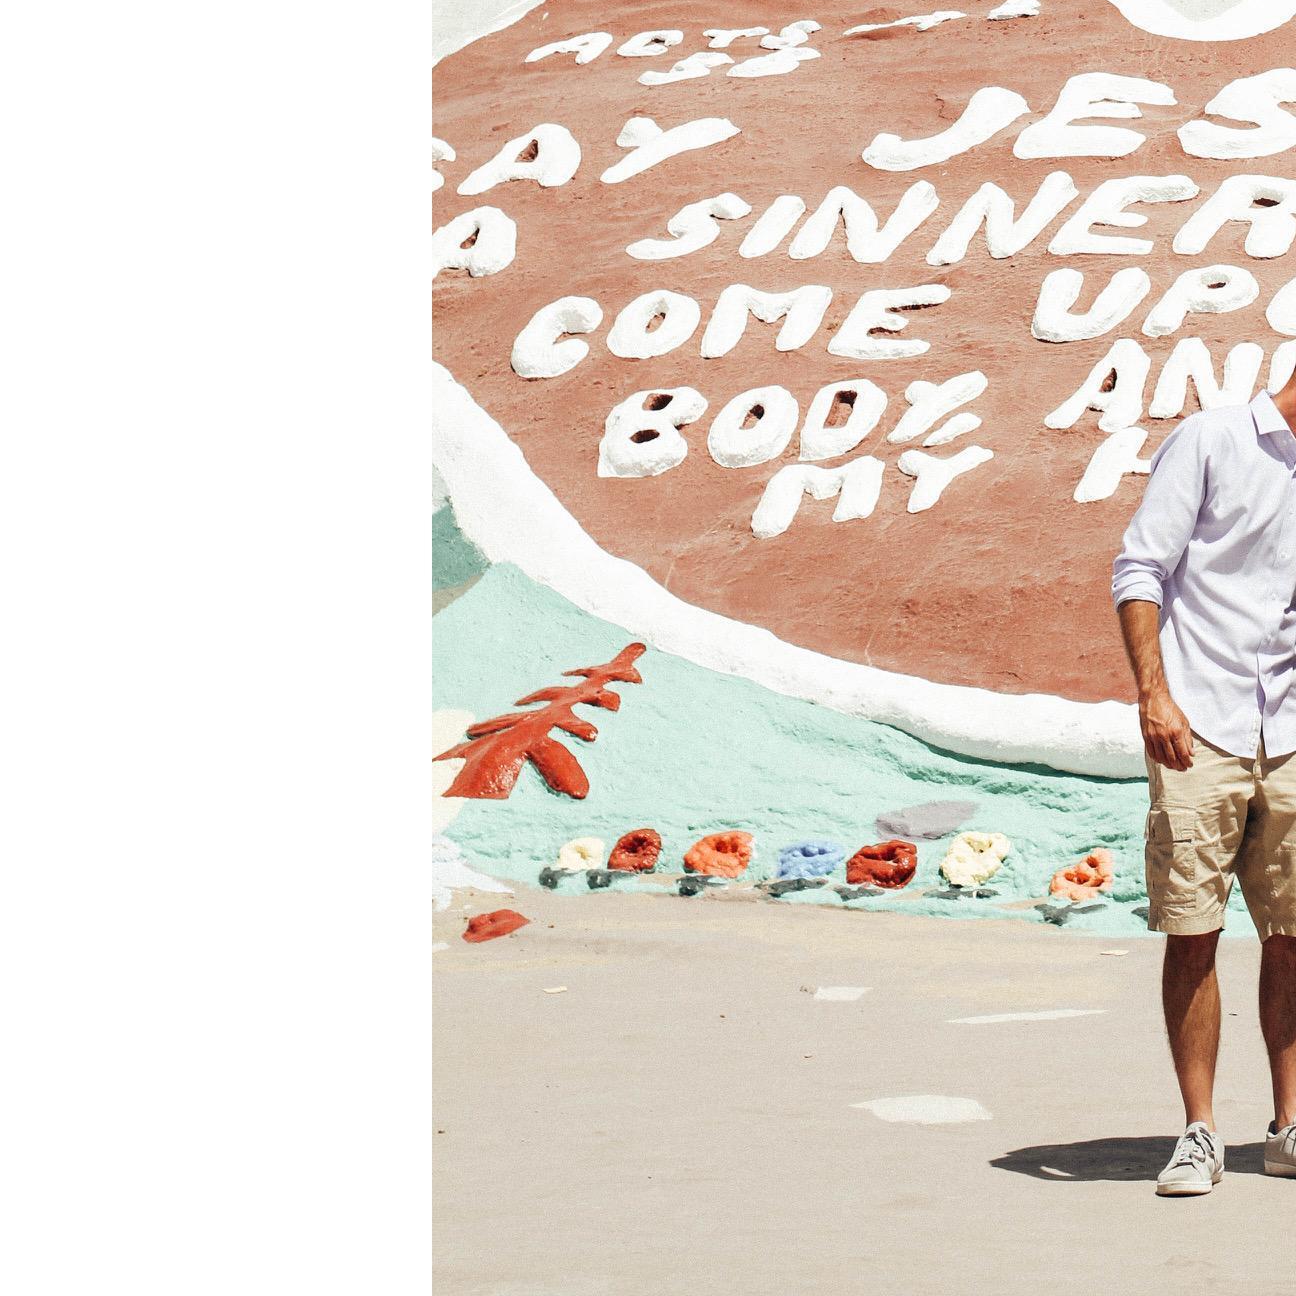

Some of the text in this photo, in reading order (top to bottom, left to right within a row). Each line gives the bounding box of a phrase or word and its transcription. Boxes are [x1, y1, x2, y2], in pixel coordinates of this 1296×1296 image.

[524, 19, 824, 66] ACTS
[432, 204, 518, 278] A
[509, 282, 953, 380] COME
[596, 369, 990, 479] BODY
[750, 454, 995, 539] MY
